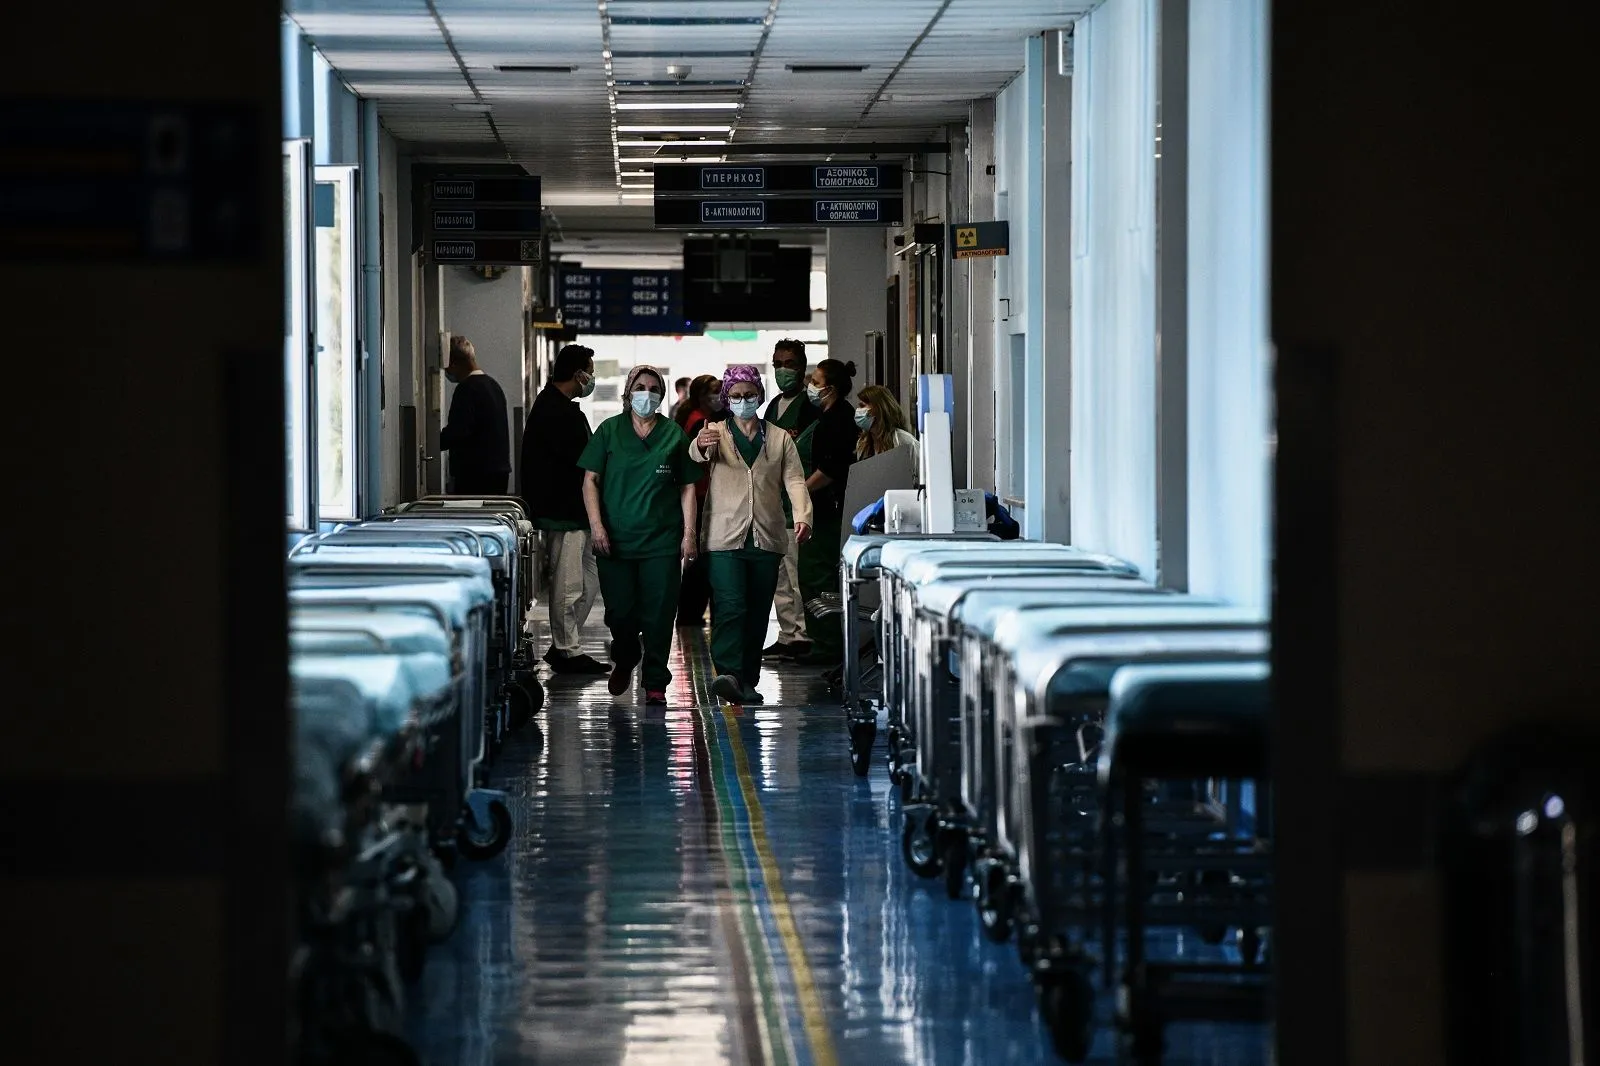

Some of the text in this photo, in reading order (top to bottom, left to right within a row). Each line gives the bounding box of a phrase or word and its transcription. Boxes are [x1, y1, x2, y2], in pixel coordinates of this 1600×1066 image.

[827, 169, 868, 177] ΑΞΟΝΙΚΟΣ
[705, 173, 761, 183] ΥΠΕΡΗΧΟΣ
[819, 178, 875, 186] ΤΟΜΟΓΡΑΦΟΣ
[829, 202, 876, 211] ΑΚΤΙΝΟΛΟΓΙΚΟ
[829, 211, 859, 220] ΘΩΡΑΚΟΣ
[960, 249, 1002, 257] ΑΚΤΙΝΟΛΟΓΙΚΟ
